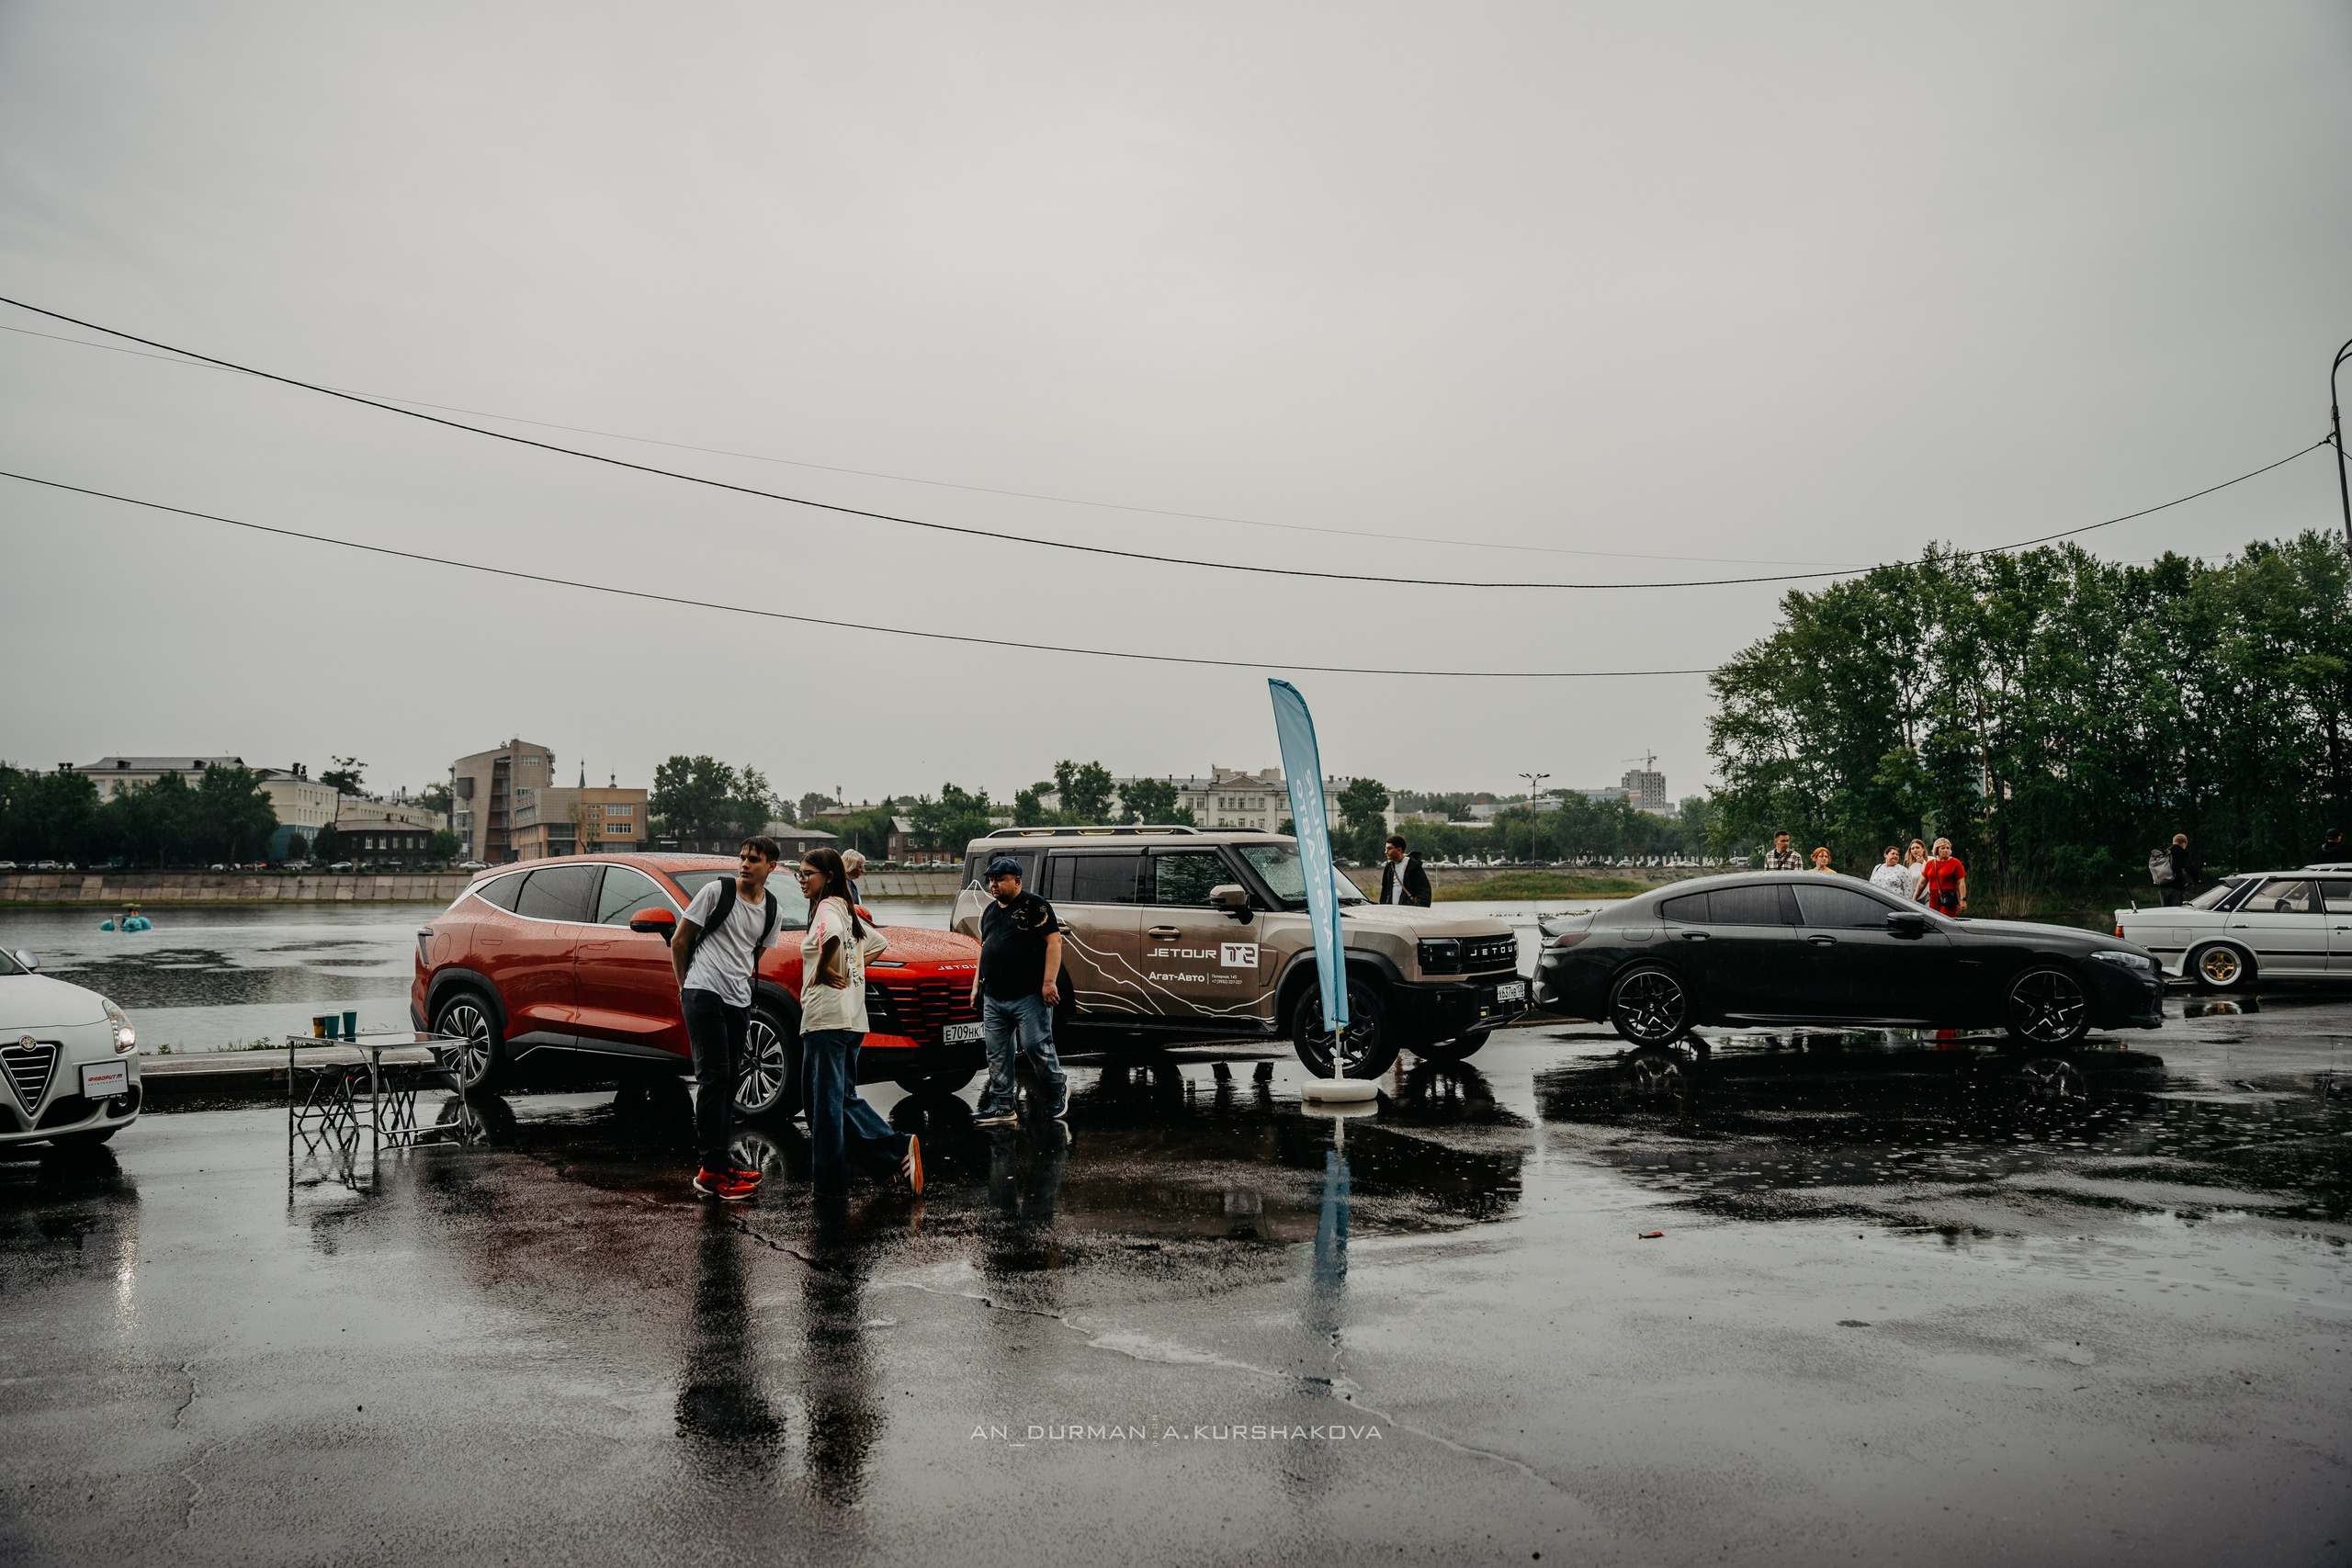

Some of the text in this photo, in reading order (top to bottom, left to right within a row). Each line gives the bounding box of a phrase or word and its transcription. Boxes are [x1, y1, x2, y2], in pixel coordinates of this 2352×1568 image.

[1147, 945, 1256, 964] JETOUR T2
[1148, 971, 1205, 983] Агат-Авто
